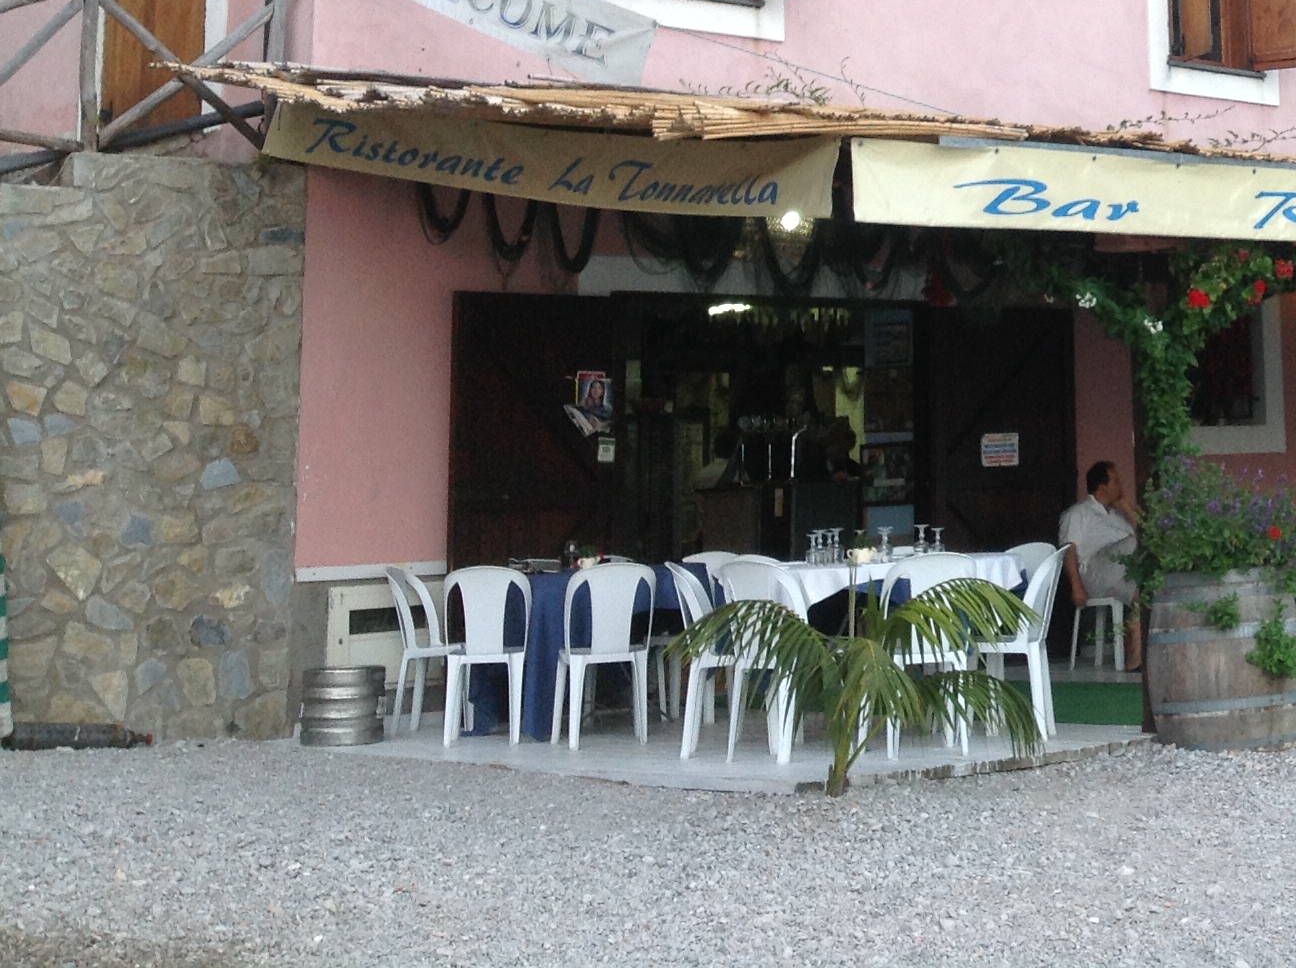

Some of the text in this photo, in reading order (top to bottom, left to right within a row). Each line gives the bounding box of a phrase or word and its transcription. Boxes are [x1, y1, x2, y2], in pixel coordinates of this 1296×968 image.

[305, 118, 779, 206] Ristorante La Tonnarella
[953, 178, 1140, 222] Bar
